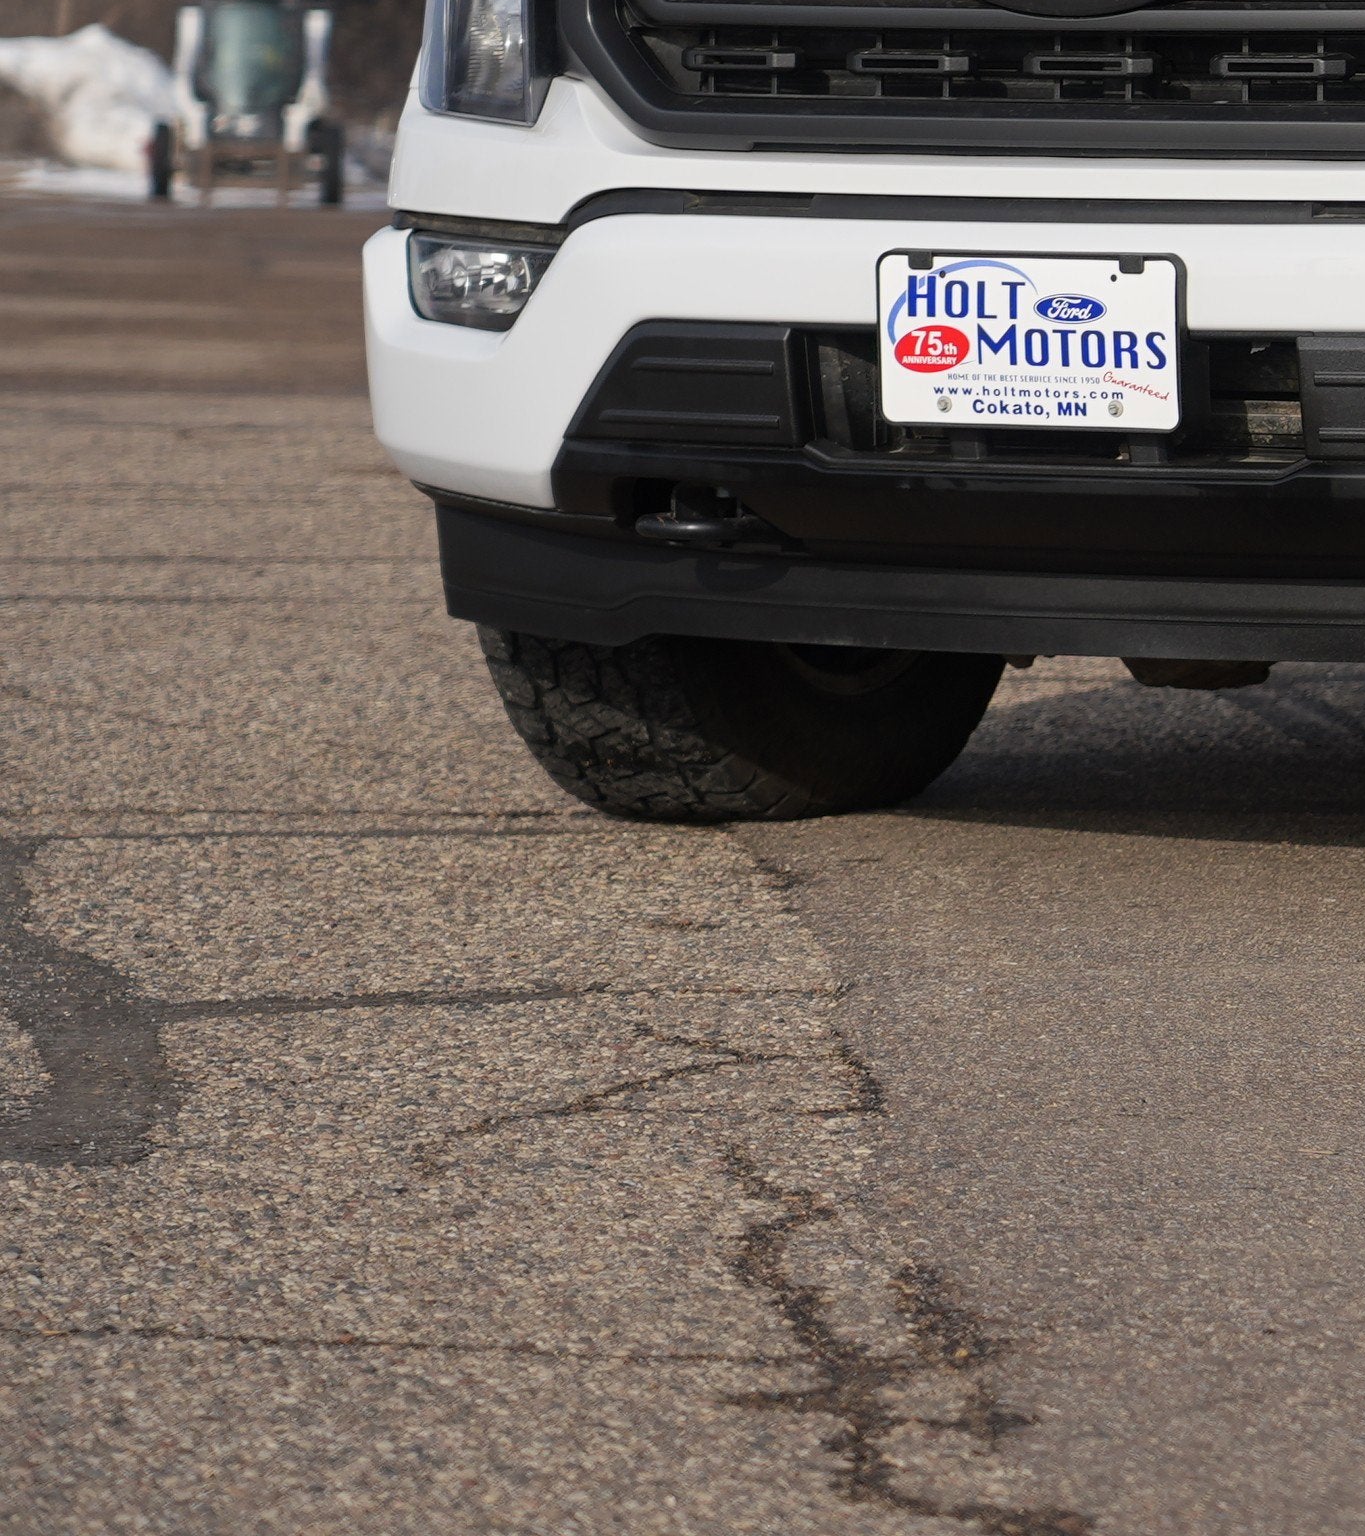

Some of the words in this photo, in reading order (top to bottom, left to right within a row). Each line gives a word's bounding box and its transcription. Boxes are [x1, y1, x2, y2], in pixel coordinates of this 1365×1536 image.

[907, 275, 1026, 320] HOLT
[1046, 297, 1093, 320] Ford
[910, 331, 958, 356] 75th
[977, 323, 1167, 370] MOTORS
[902, 355, 957, 366] ANNIVERSARY
[948, 373, 969, 382] HOME
[972, 374, 981, 382] OF
[984, 374, 996, 382] THE
[1000, 375, 1017, 383] BEST
[1054, 376, 1077, 384] SINCE
[1081, 377, 1100, 385] 1950
[1103, 371, 1169, 400] Guaranteed
[933, 386, 1124, 400] www.holtmotors.com
[972, 399, 1050, 419] Cokato,
[1057, 402, 1087, 416] MN
